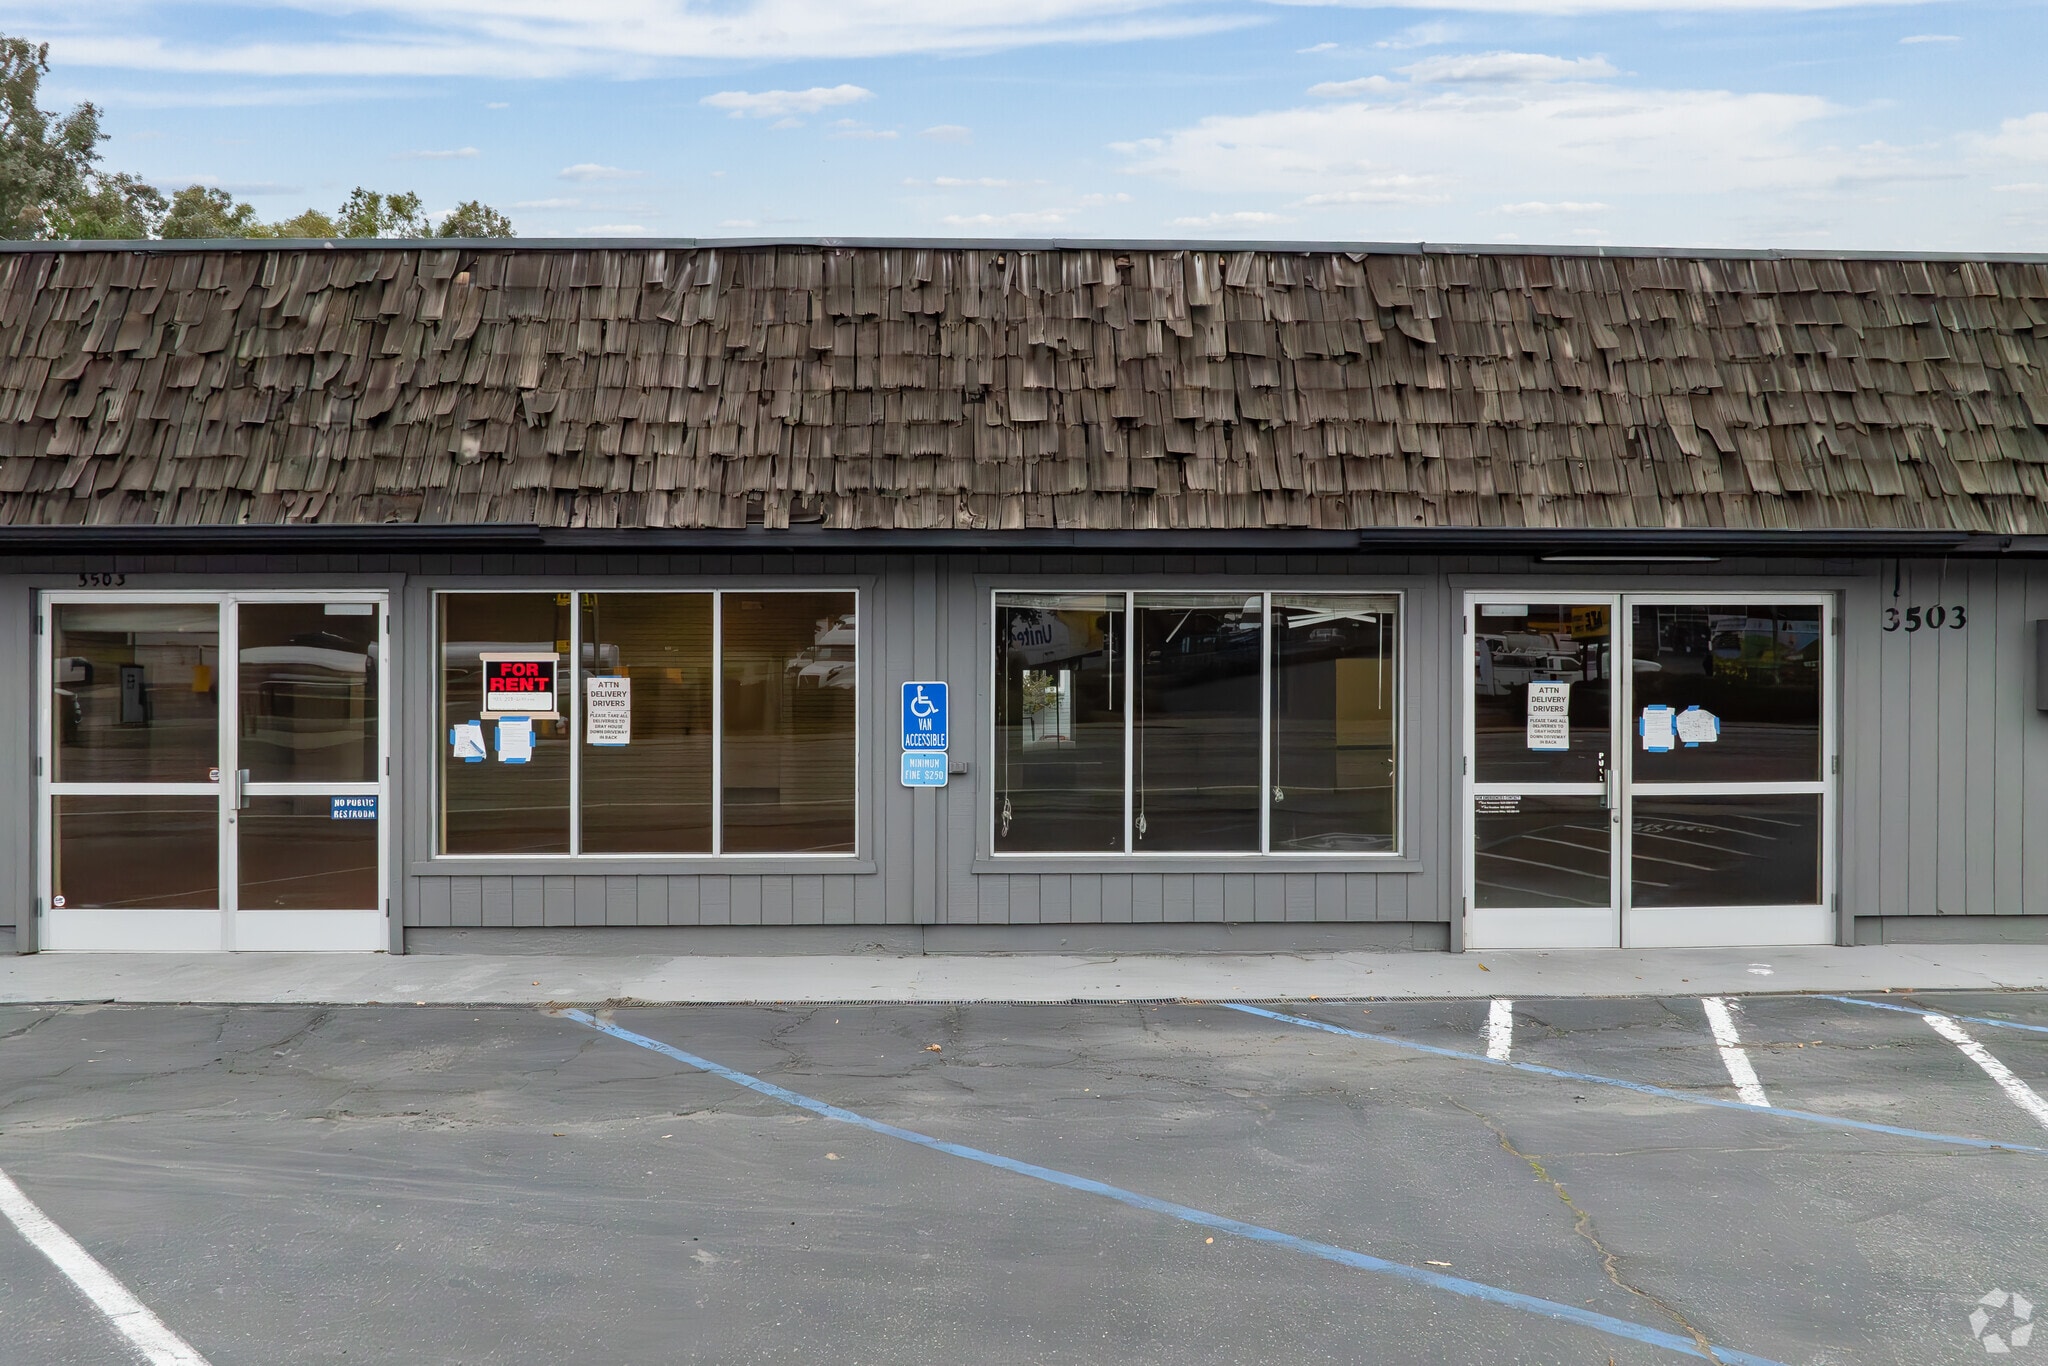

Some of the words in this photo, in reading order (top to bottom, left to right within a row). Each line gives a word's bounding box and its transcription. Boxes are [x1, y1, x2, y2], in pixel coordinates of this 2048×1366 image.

[77, 573, 126, 588] 3503
[1882, 604, 1967, 632] 3503
[500, 663, 539, 677] FOR
[490, 678, 550, 691] RENT
[918, 718, 932, 730] VAN
[905, 734, 945, 746] ACCESSIBLE
[910, 759, 940, 768] MINIMUM
[905, 770, 921, 780] FINE
[924, 770, 944, 780] $250
[334, 799, 345, 807] NO
[334, 810, 375, 818] RESTROOM
